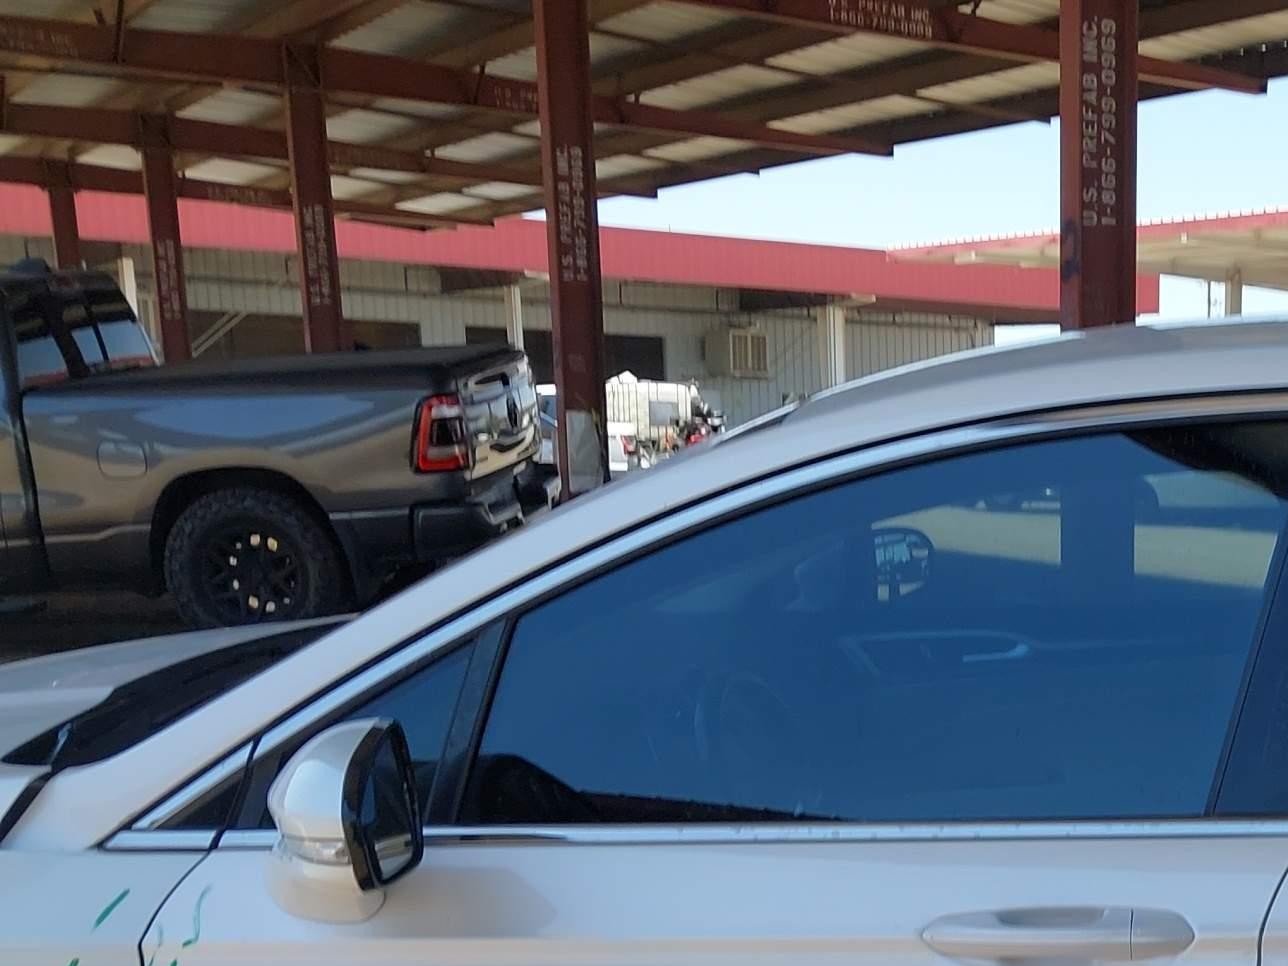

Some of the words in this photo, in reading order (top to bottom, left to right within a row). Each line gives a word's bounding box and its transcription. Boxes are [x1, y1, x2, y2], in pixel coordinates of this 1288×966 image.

[1083, 16, 1098, 63] INC.
[1083, 73, 1098, 169] PREFAB
[1101, 18, 1117, 226] 1-866-799-0969
[1083, 181, 1098, 226] U.S.
